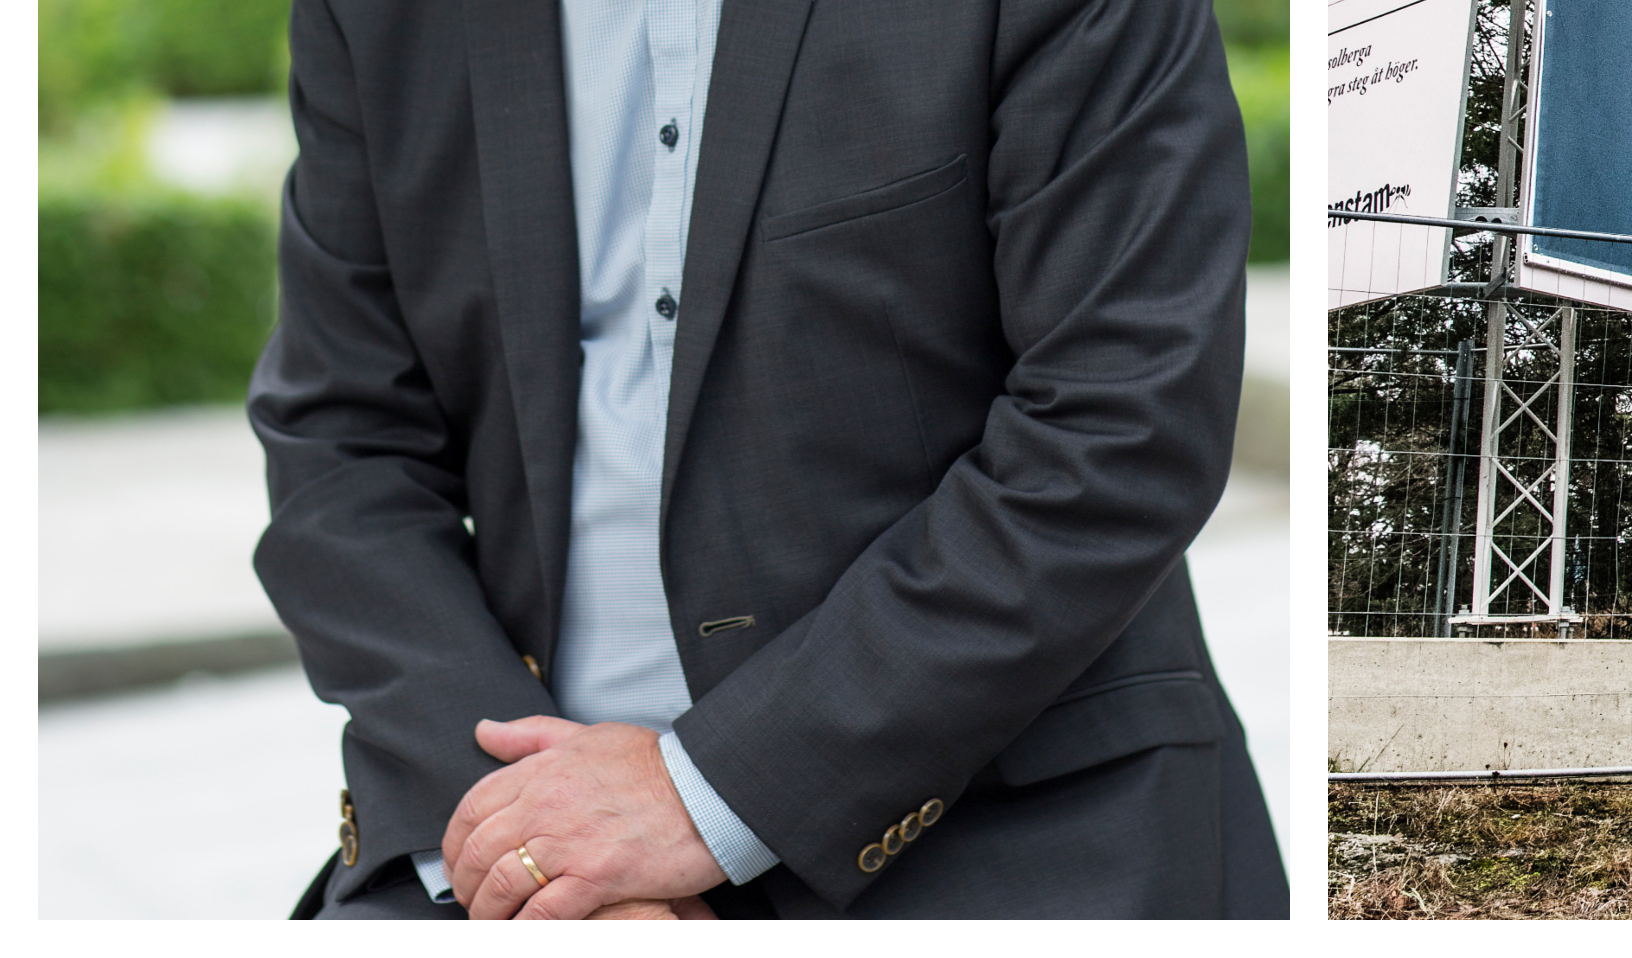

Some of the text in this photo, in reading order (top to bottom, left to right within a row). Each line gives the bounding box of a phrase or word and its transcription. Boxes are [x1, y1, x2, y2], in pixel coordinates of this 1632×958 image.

[1328, 44, 1372, 71] solberga
[1346, 75, 1369, 96] steg
[1370, 67, 1384, 85] åt
[1384, 58, 1419, 83] höger.
